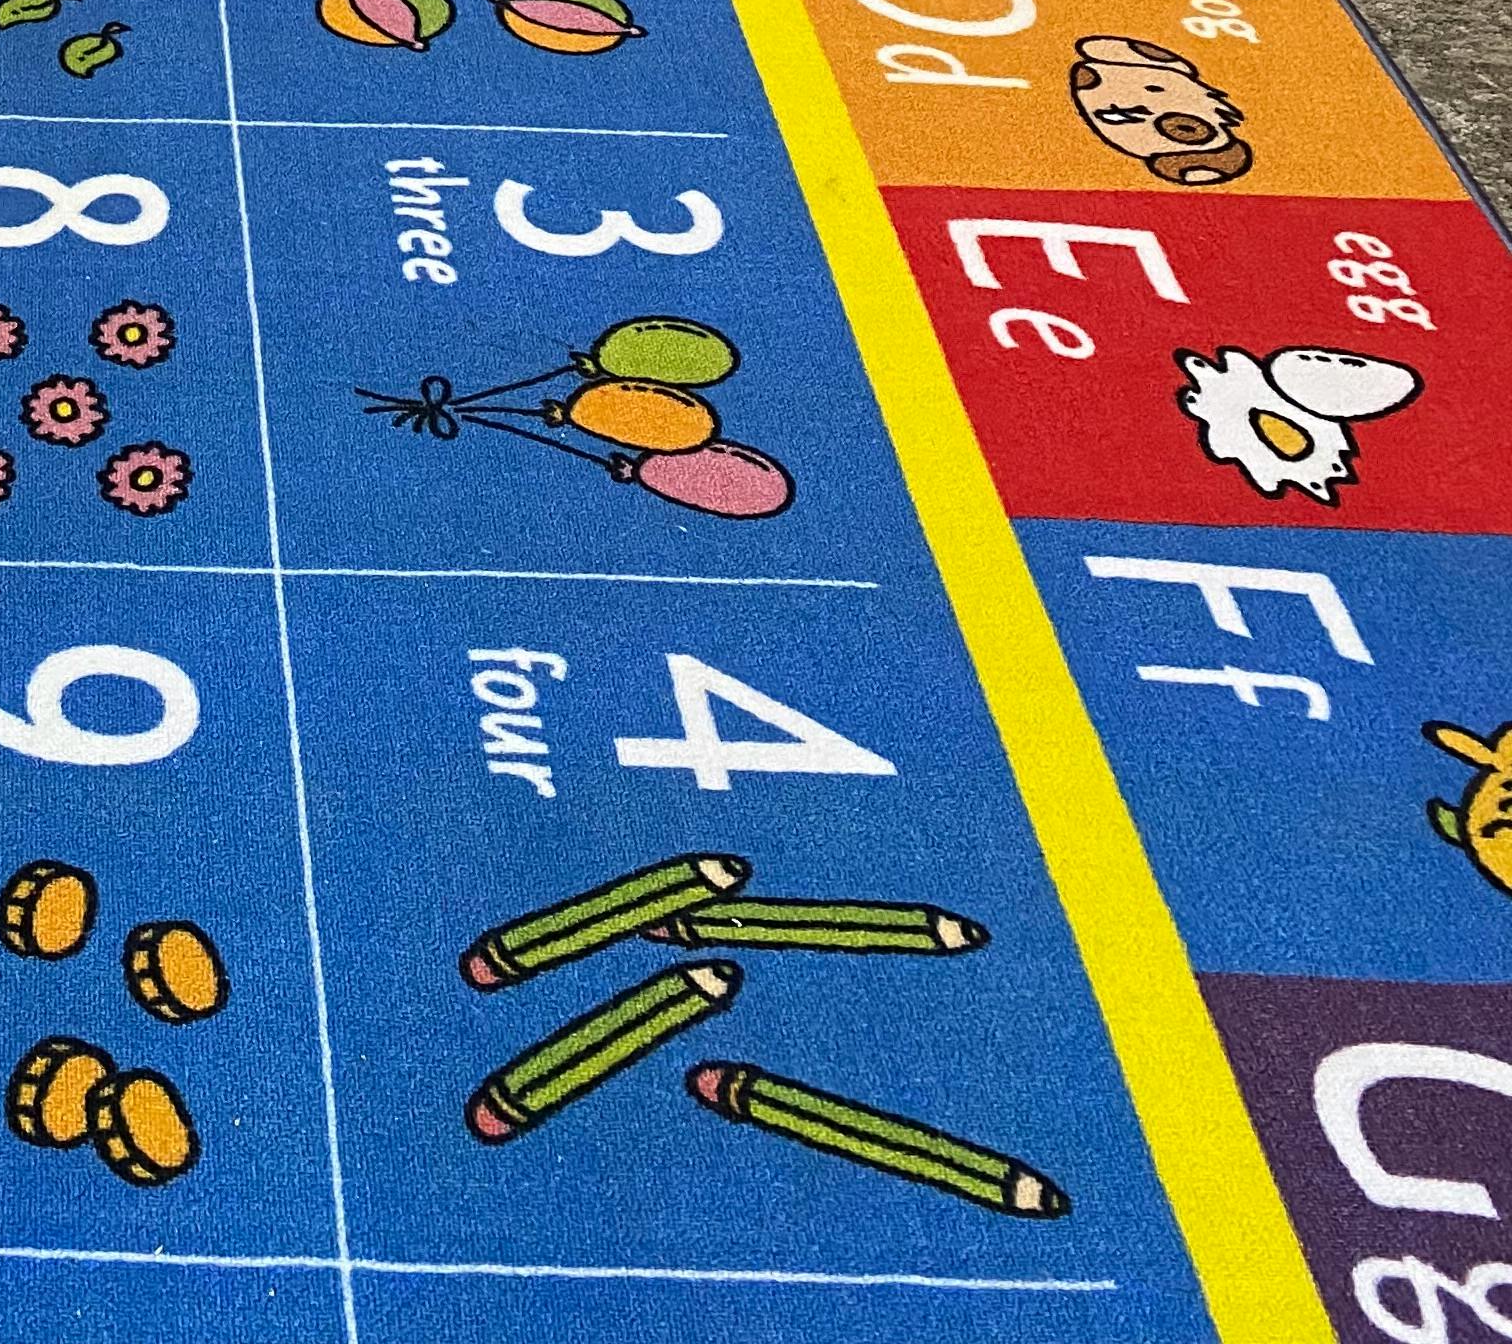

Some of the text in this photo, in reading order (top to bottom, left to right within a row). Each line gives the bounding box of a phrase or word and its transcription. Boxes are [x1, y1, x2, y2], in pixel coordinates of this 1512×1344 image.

[385, 157, 470, 284] three
[494, 179, 723, 256] 3
[1328, 232, 1437, 329] egg
[468, 647, 568, 797] four
[614, 653, 897, 790] 4
